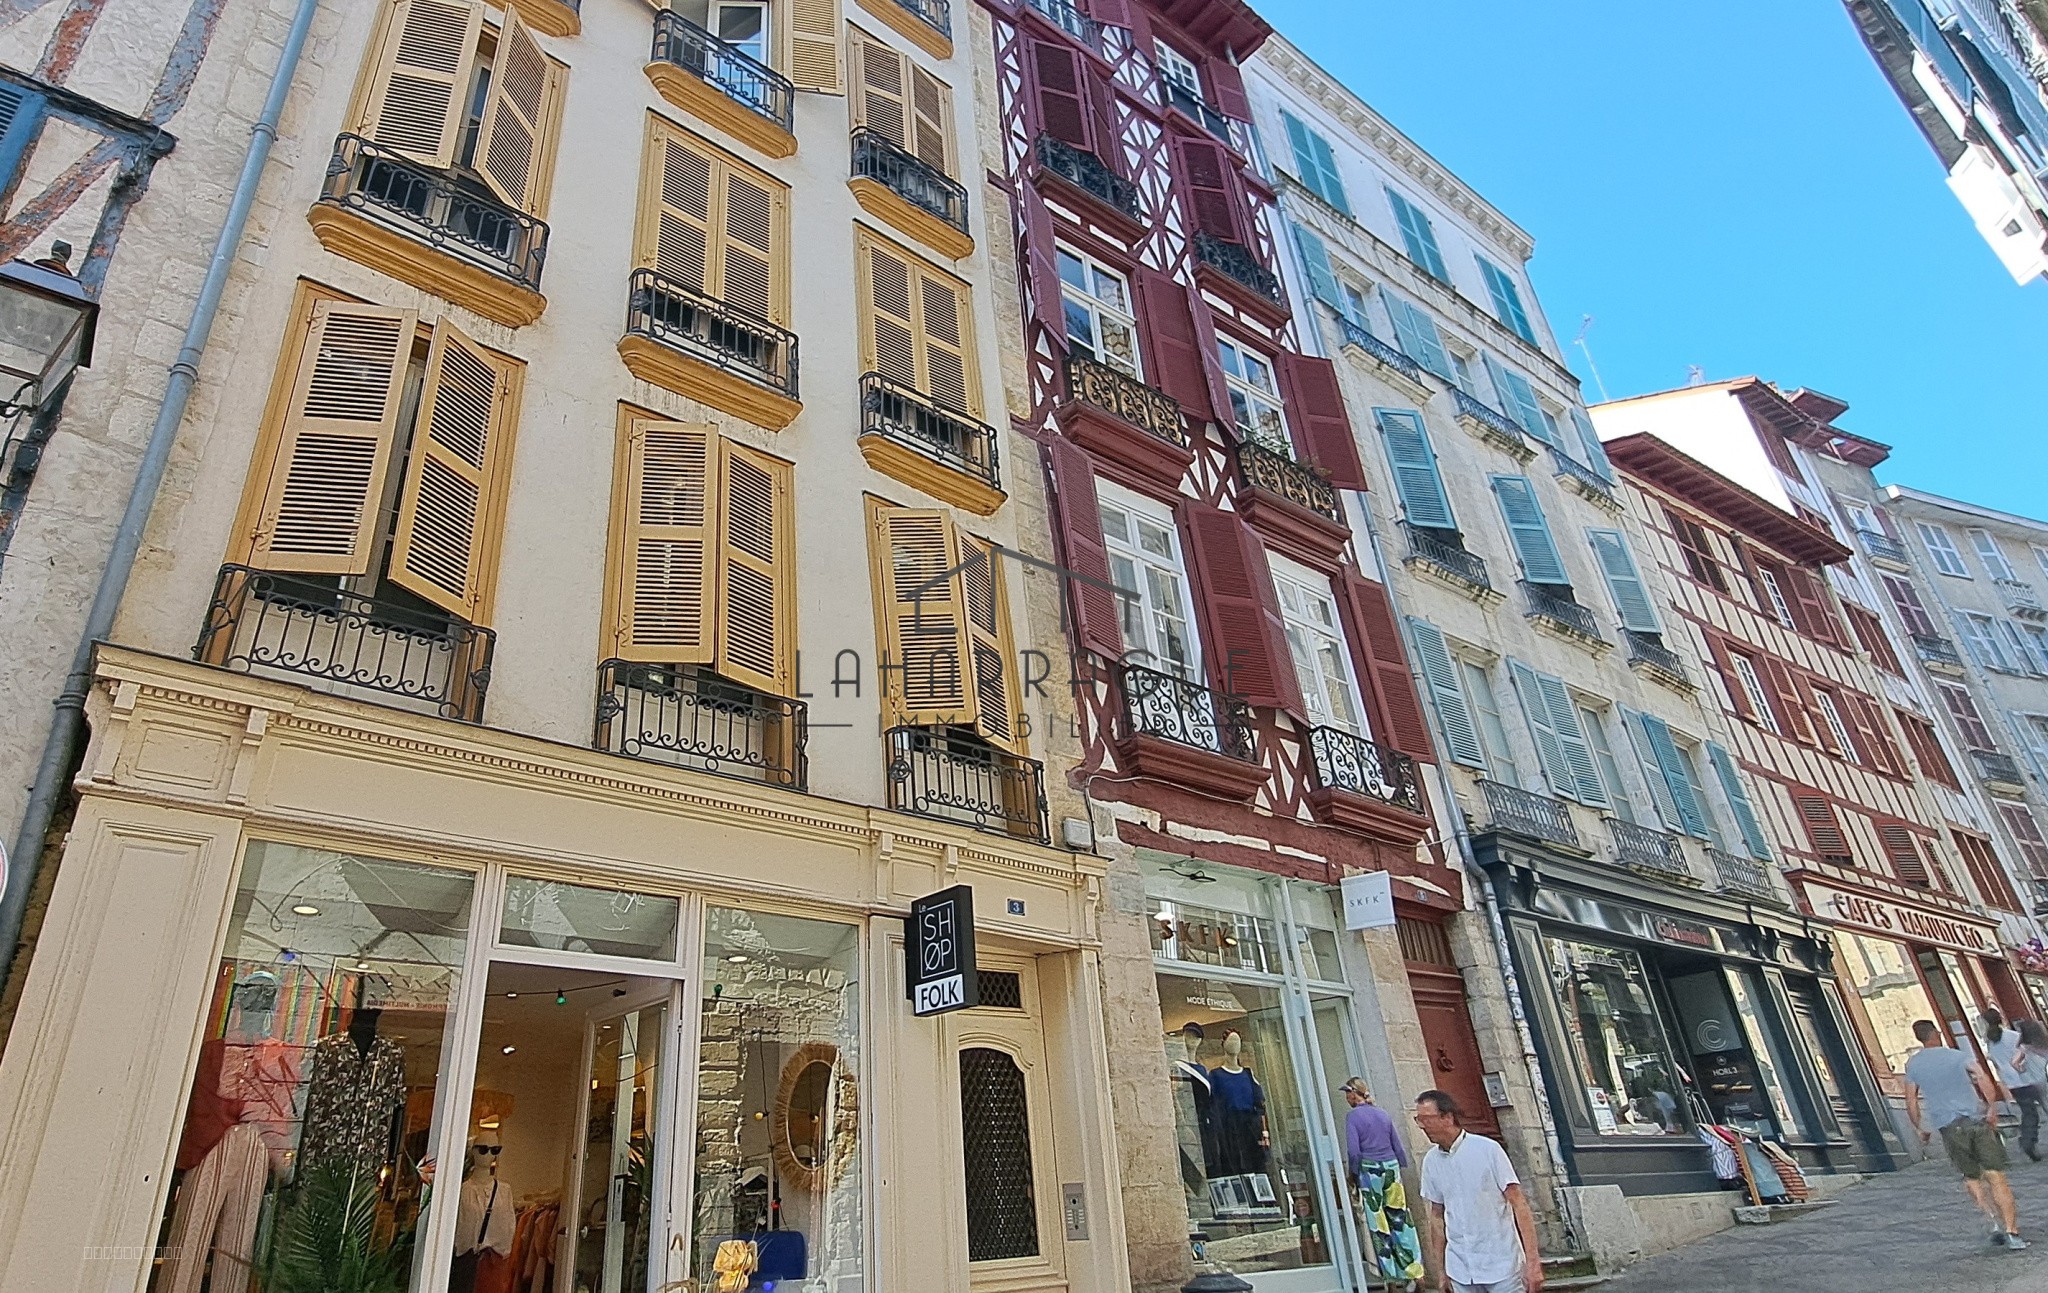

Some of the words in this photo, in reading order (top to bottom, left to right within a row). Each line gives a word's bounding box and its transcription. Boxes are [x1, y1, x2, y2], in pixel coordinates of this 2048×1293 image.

[1013, 902, 1020, 913] 3
[1349, 895, 1380, 908] SKFK
[918, 904, 928, 914] Le
[920, 980, 960, 1010] FOLK
